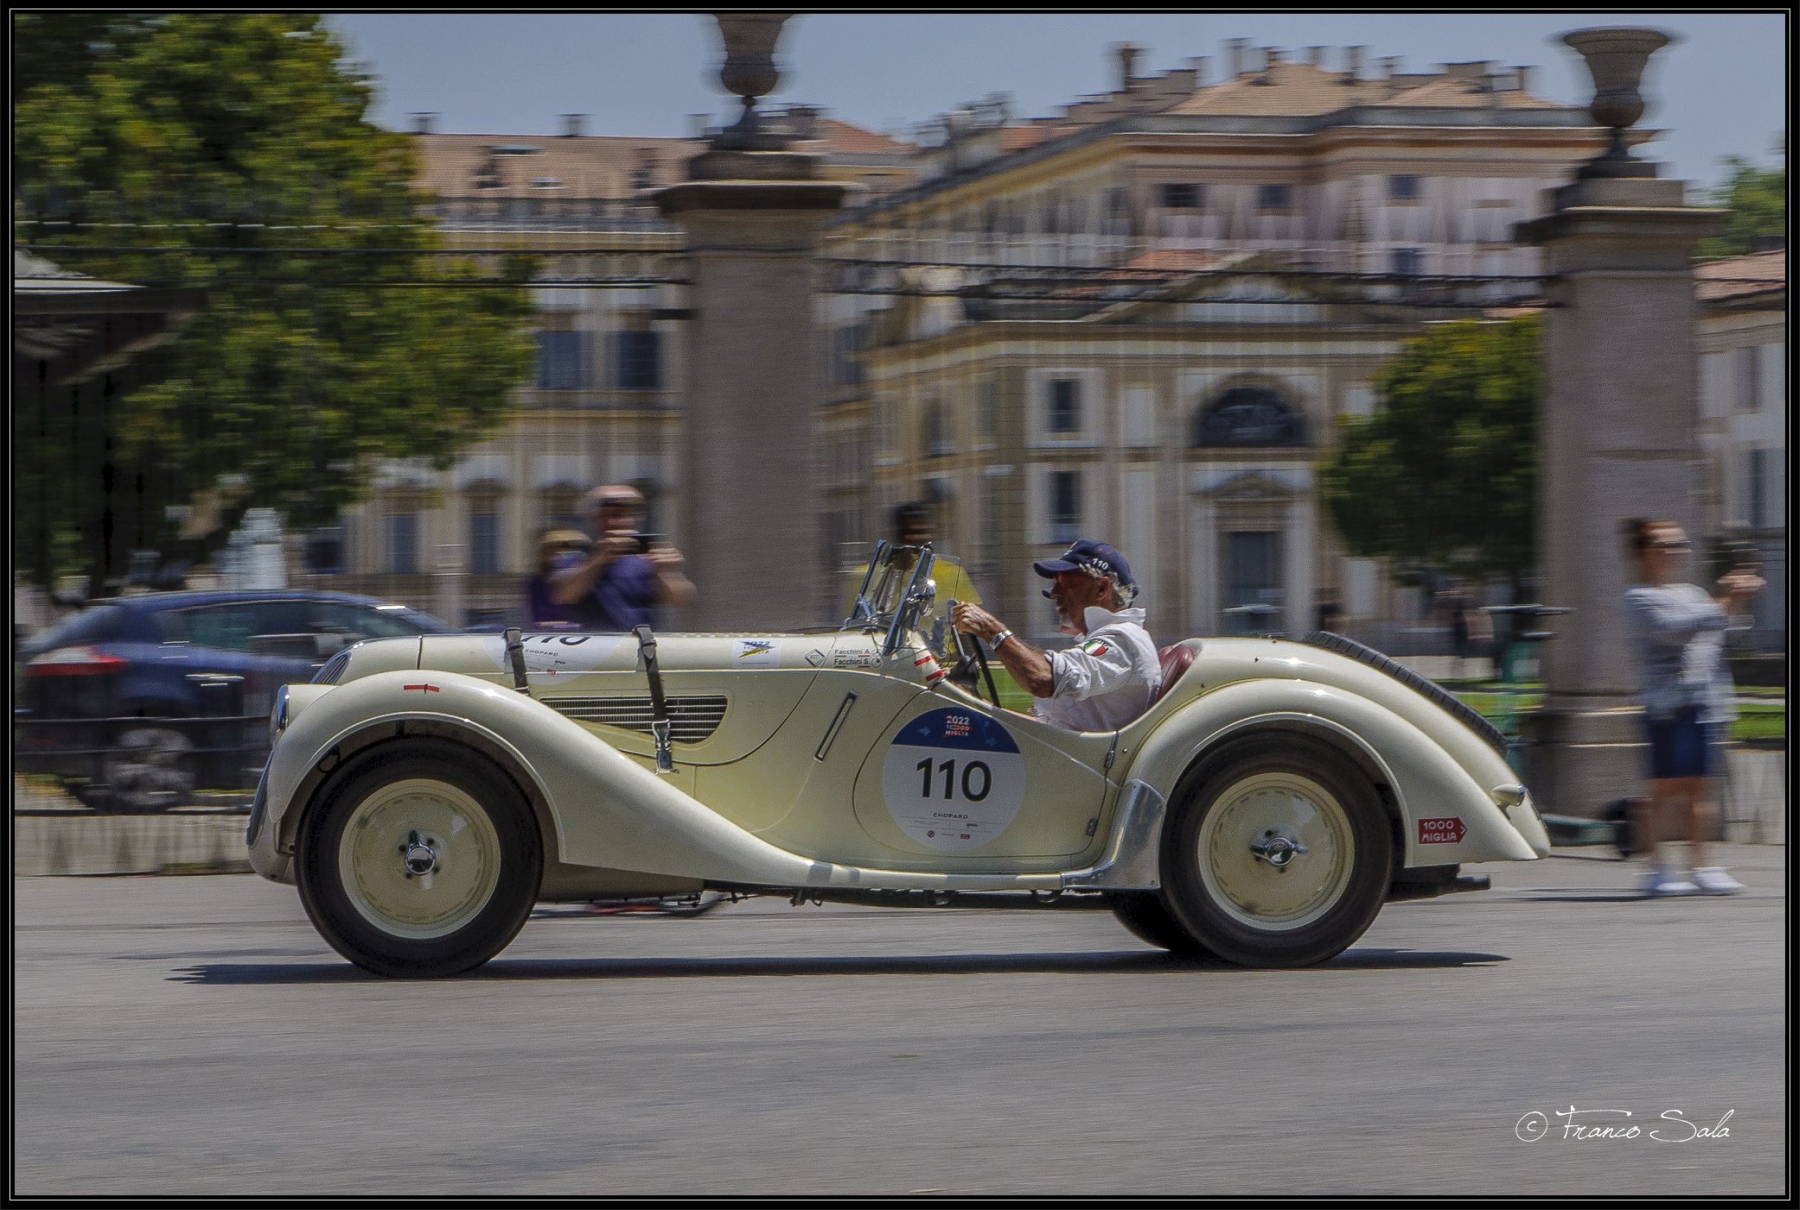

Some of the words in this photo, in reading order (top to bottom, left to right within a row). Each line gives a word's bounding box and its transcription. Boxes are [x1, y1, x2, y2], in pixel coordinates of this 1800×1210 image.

[1092, 558, 1109, 570] 110
[946, 715, 970, 725] 2022
[916, 757, 992, 803] 110
[933, 812, 969, 820] CHOPARD
[1423, 820, 1455, 830] 1000
[1421, 832, 1457, 842] MIGLIA
